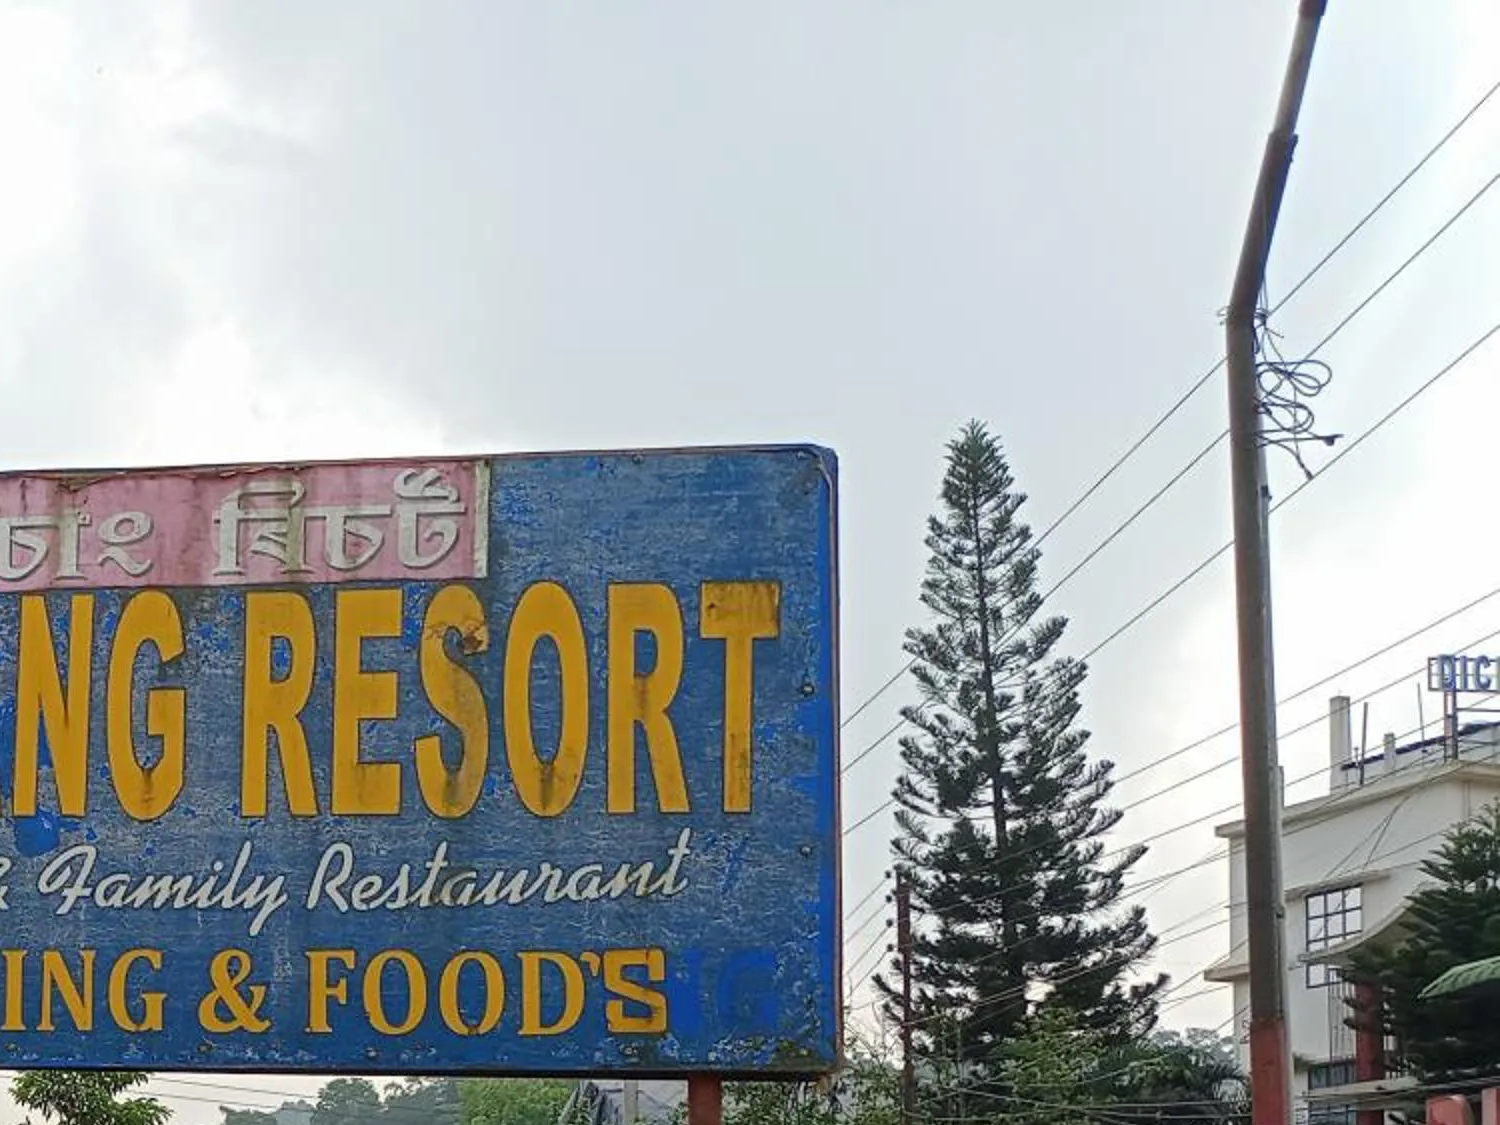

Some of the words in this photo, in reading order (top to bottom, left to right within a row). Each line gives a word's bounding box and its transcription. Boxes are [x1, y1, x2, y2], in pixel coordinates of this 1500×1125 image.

[240, 579, 781, 819] RESORT
[1439, 654, 1500, 691] DIC
[37, 840, 287, 937] Family
[305, 827, 693, 913] Restaurant
[198, 947, 273, 1034] &
[304, 946, 668, 1037] FOOD'S
